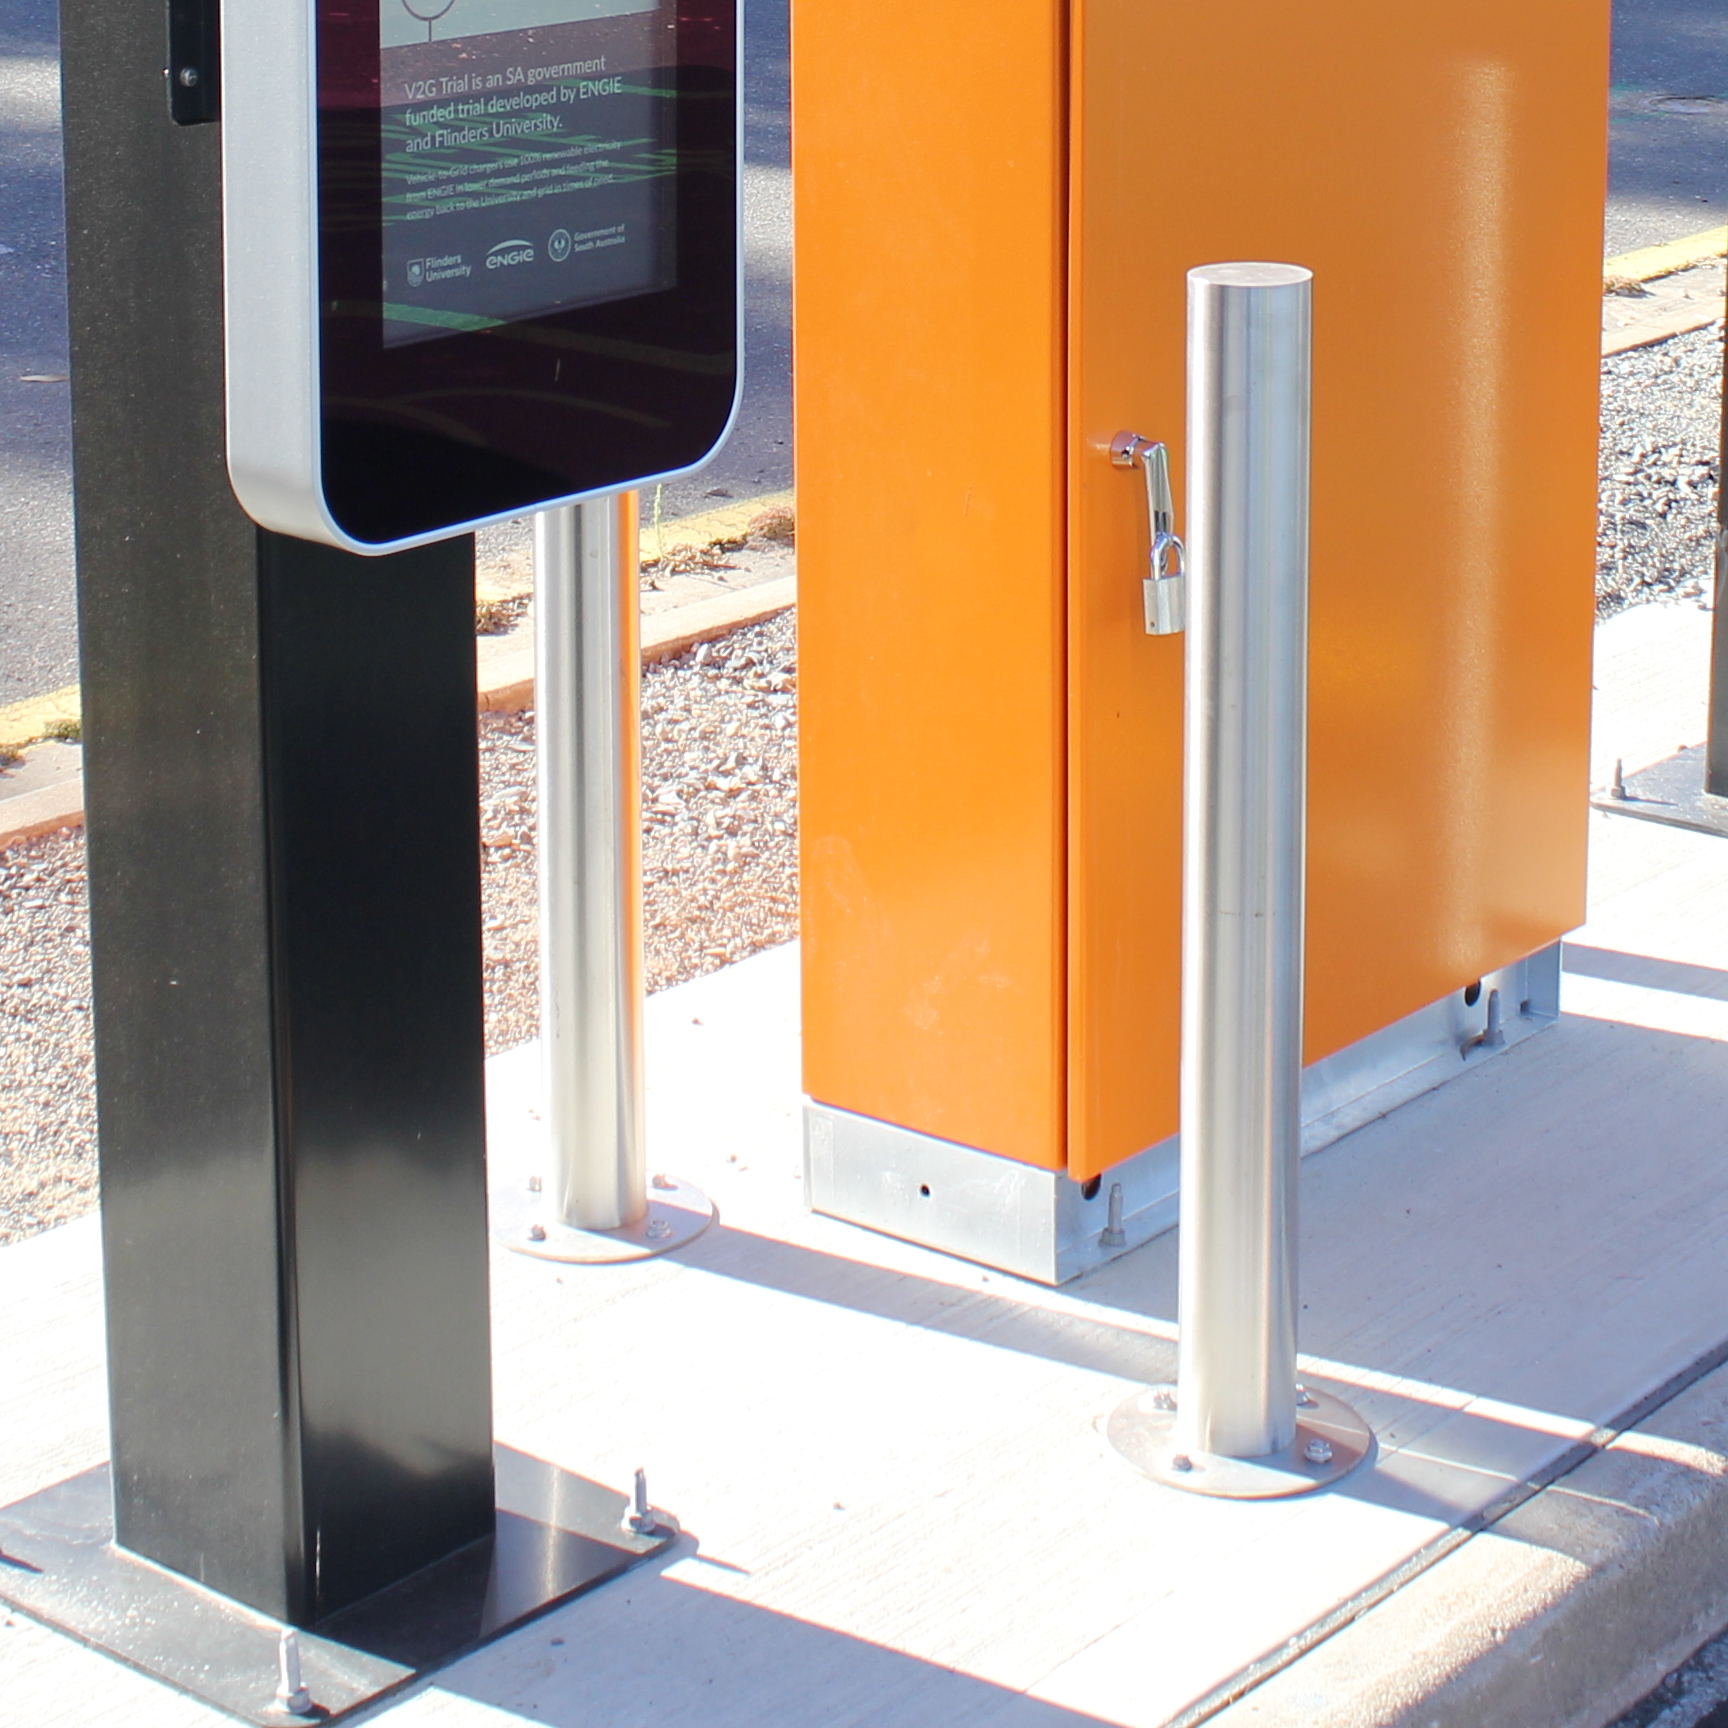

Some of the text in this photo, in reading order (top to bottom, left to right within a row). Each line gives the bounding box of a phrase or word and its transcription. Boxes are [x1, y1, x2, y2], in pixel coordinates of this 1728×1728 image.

[404, 55, 606, 100] V2G Trial is an SA government
[405, 76, 623, 127] funded trial developed by ENGIE
[405, 113, 563, 153] and Flinders University.
[520, 153, 542, 165] 100%
[542, 146, 583, 161] renewable
[427, 184, 454, 199] ENGIE
[488, 173, 520, 188] demand
[521, 168, 550, 184] periods
[480, 190, 521, 207] University
[574, 223, 626, 242] Government of
[574, 235, 626, 253] South Australia
[425, 254, 462, 270] Flinders
[425, 263, 472, 283] University
